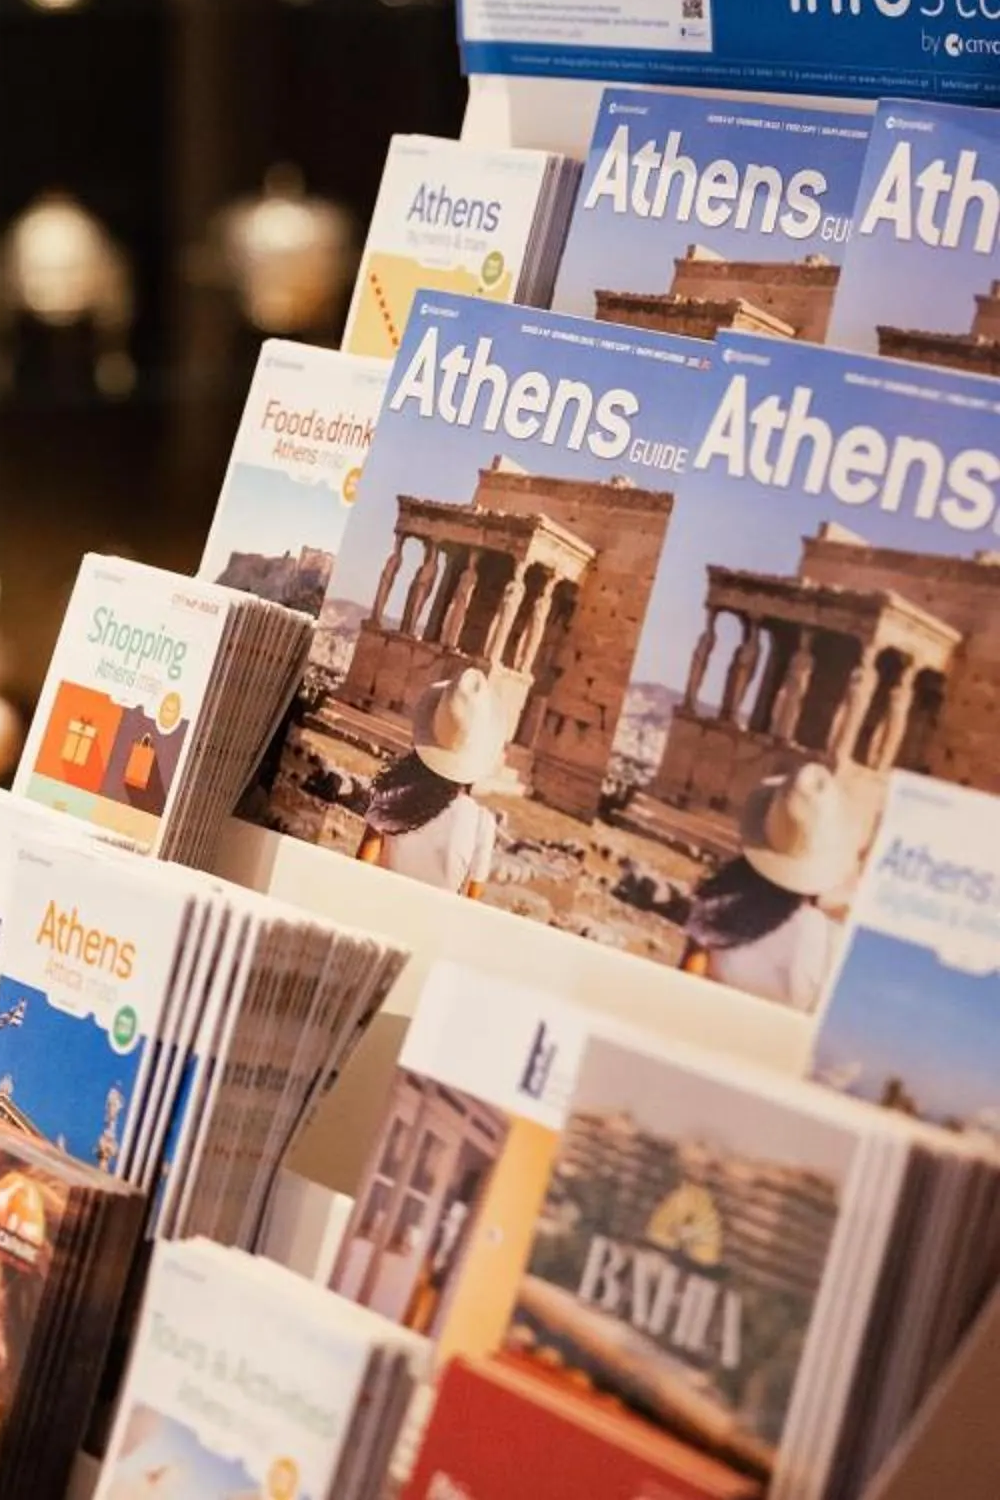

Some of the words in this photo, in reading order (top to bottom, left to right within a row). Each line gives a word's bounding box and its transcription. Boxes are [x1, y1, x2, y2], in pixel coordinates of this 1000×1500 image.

[921, 27, 940, 57] by
[406, 182, 502, 232] Athens
[582, 124, 827, 239] Athens
[859, 141, 1000, 255] Ath
[388, 326, 640, 460] Athens
[628, 438, 690, 474] GUIDE
[272, 438, 320, 466] Athens
[693, 374, 1000, 531] Athens
[87, 605, 188, 682] Shopping
[95, 657, 138, 688] Athens
[876, 837, 995, 906] Athens
[36, 899, 137, 980] Athens
